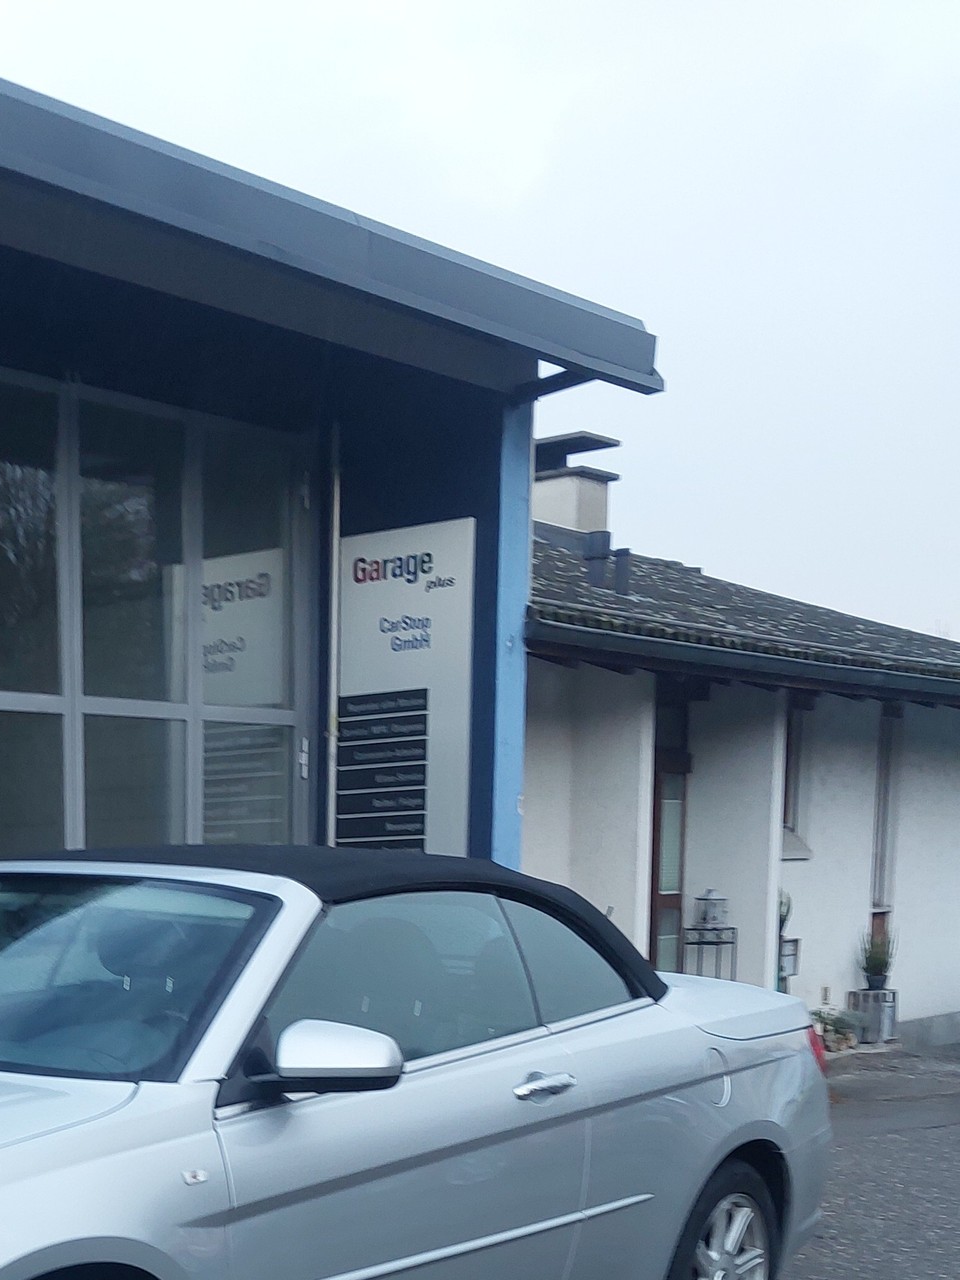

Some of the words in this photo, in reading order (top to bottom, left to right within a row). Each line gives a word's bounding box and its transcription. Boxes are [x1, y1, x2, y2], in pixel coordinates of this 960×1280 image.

[353, 552, 434, 584] Garage
[424, 576, 456, 593] plus
[390, 632, 431, 652] GmbH
